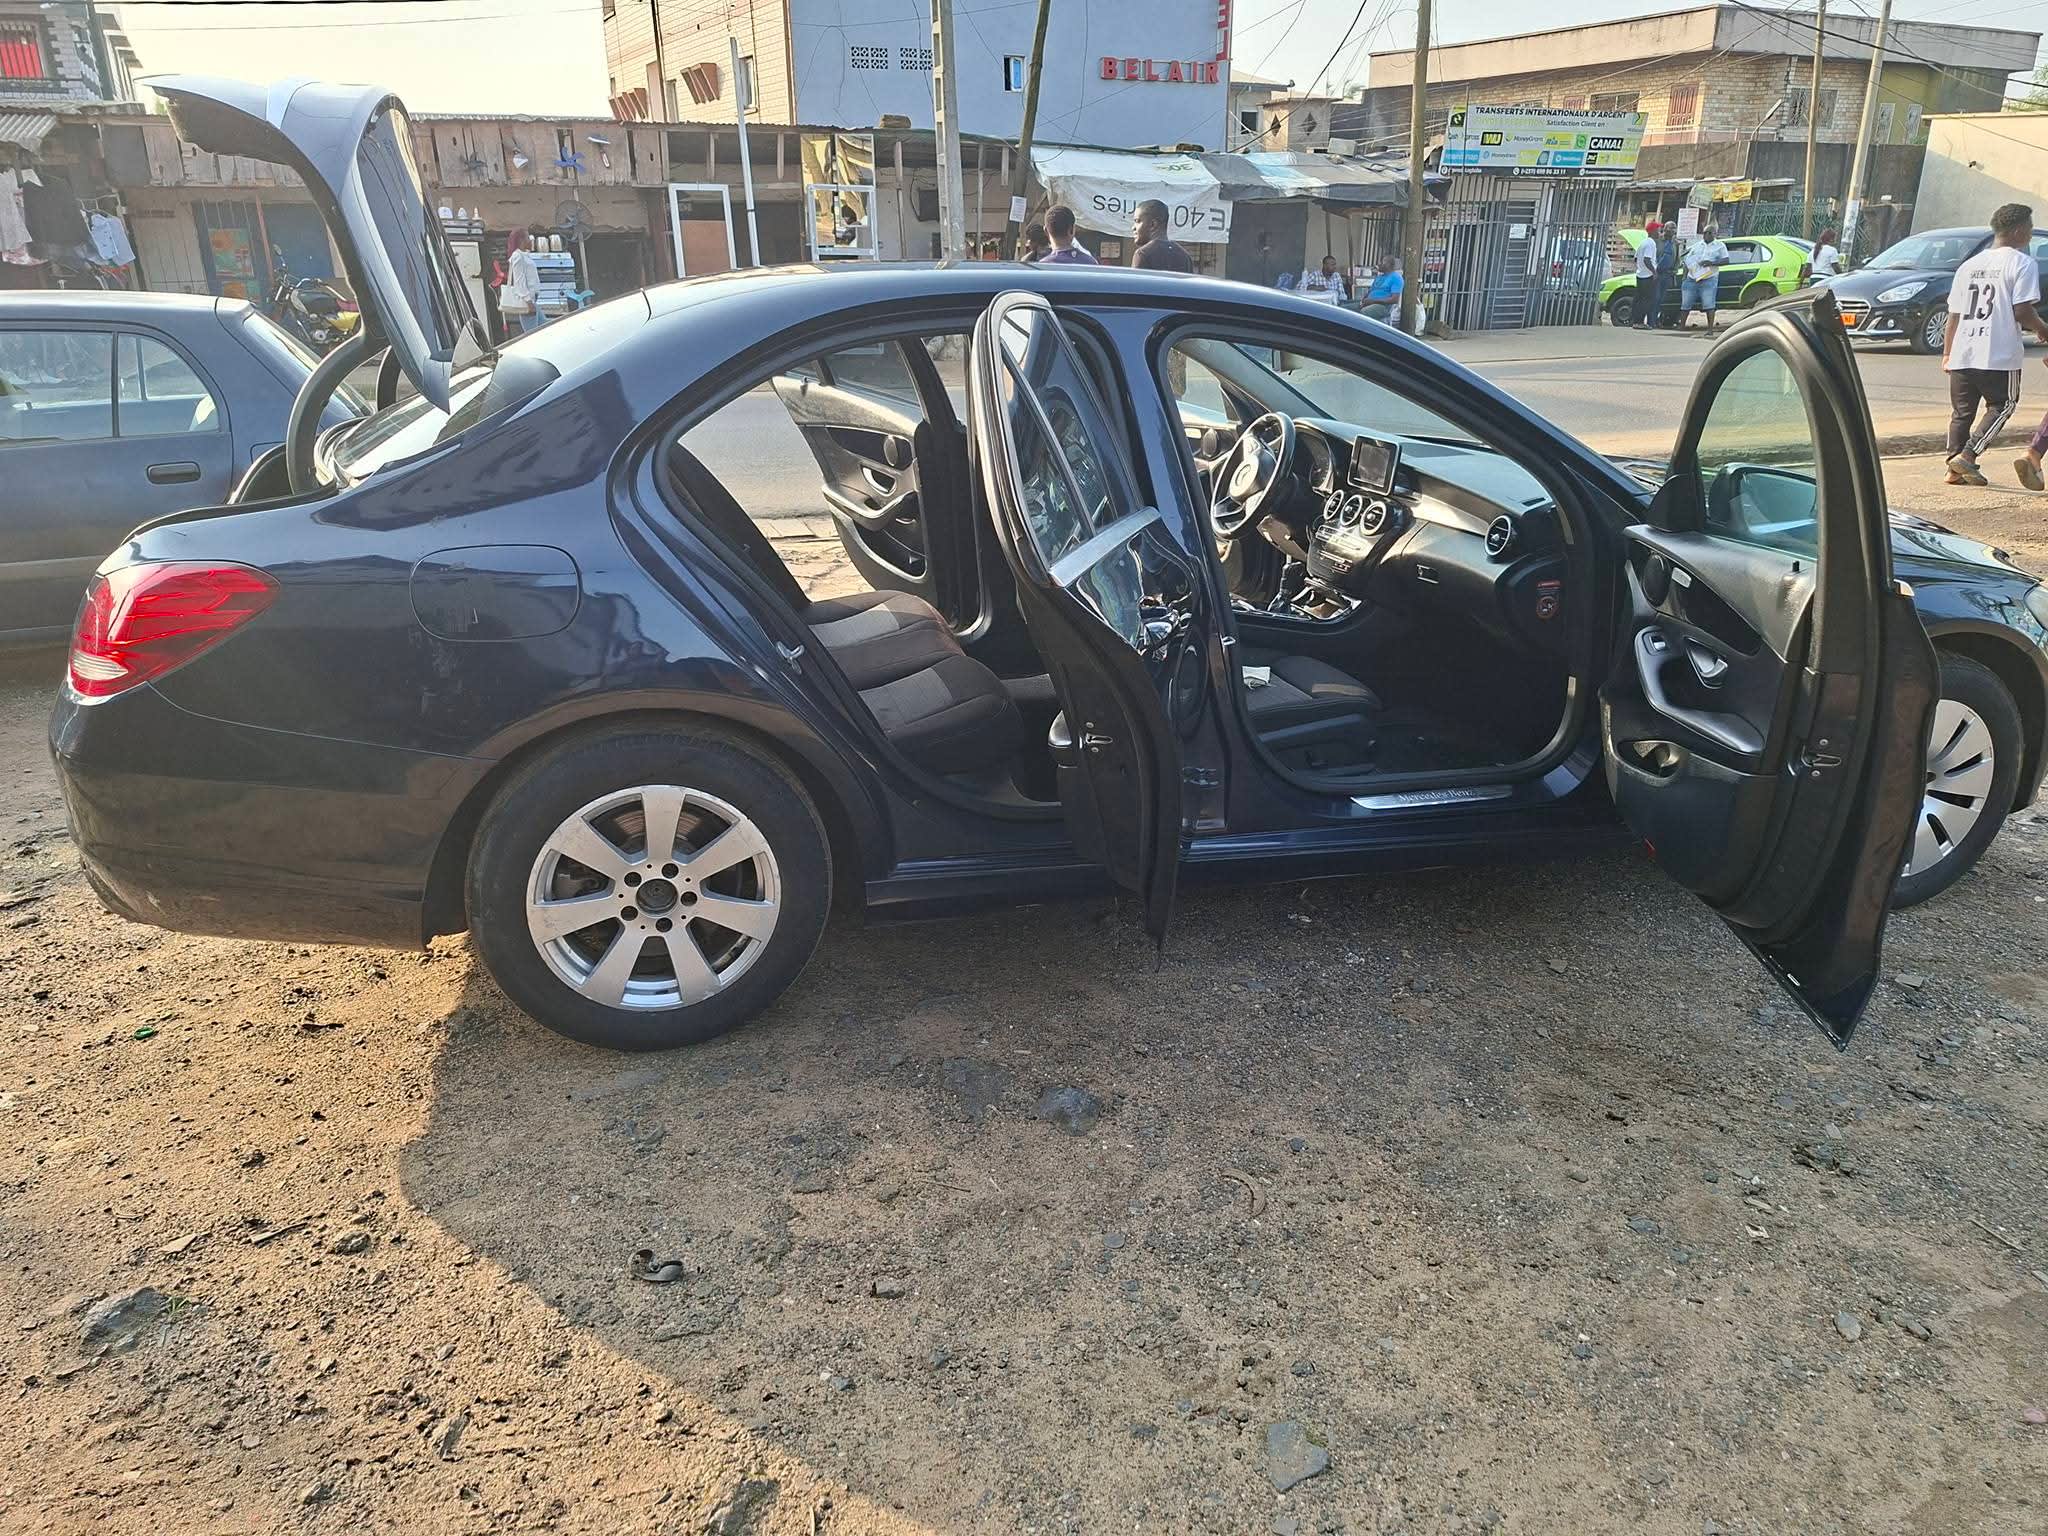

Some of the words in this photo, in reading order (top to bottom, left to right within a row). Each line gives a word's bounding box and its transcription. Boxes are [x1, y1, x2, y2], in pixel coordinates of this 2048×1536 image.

[1475, 106, 1524, 116] TRANSFERTS
[1525, 108, 1590, 118] INTERNATIONAUX
[1591, 111, 1627, 119] D'ARGENT
[1546, 119, 1579, 127] Satisfaction
[1590, 138, 1622, 150] CANAL
[1963, 283, 1996, 321] 13
